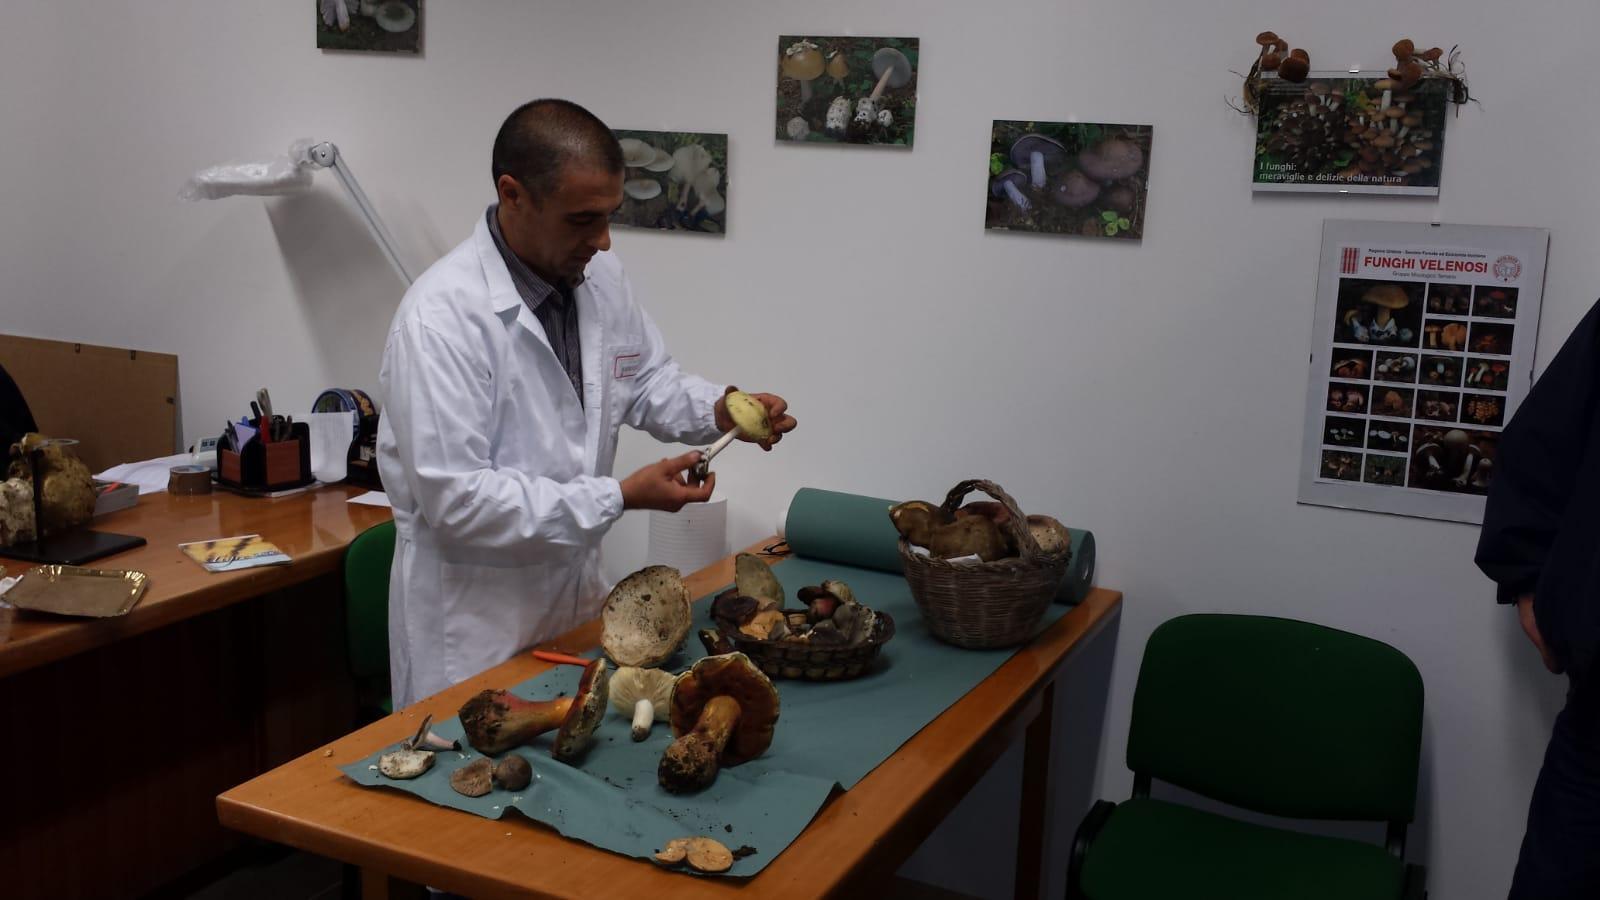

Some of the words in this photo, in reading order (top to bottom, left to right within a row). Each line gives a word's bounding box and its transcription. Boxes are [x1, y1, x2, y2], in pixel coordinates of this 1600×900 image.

[1259, 172, 1305, 182] meraviglie
[1315, 173, 1344, 182] delizie
[1346, 173, 1369, 183] della
[1371, 175, 1402, 183] natura
[1364, 256, 1415, 269] FUNGHI
[1419, 259, 1488, 273] VELENOSI
